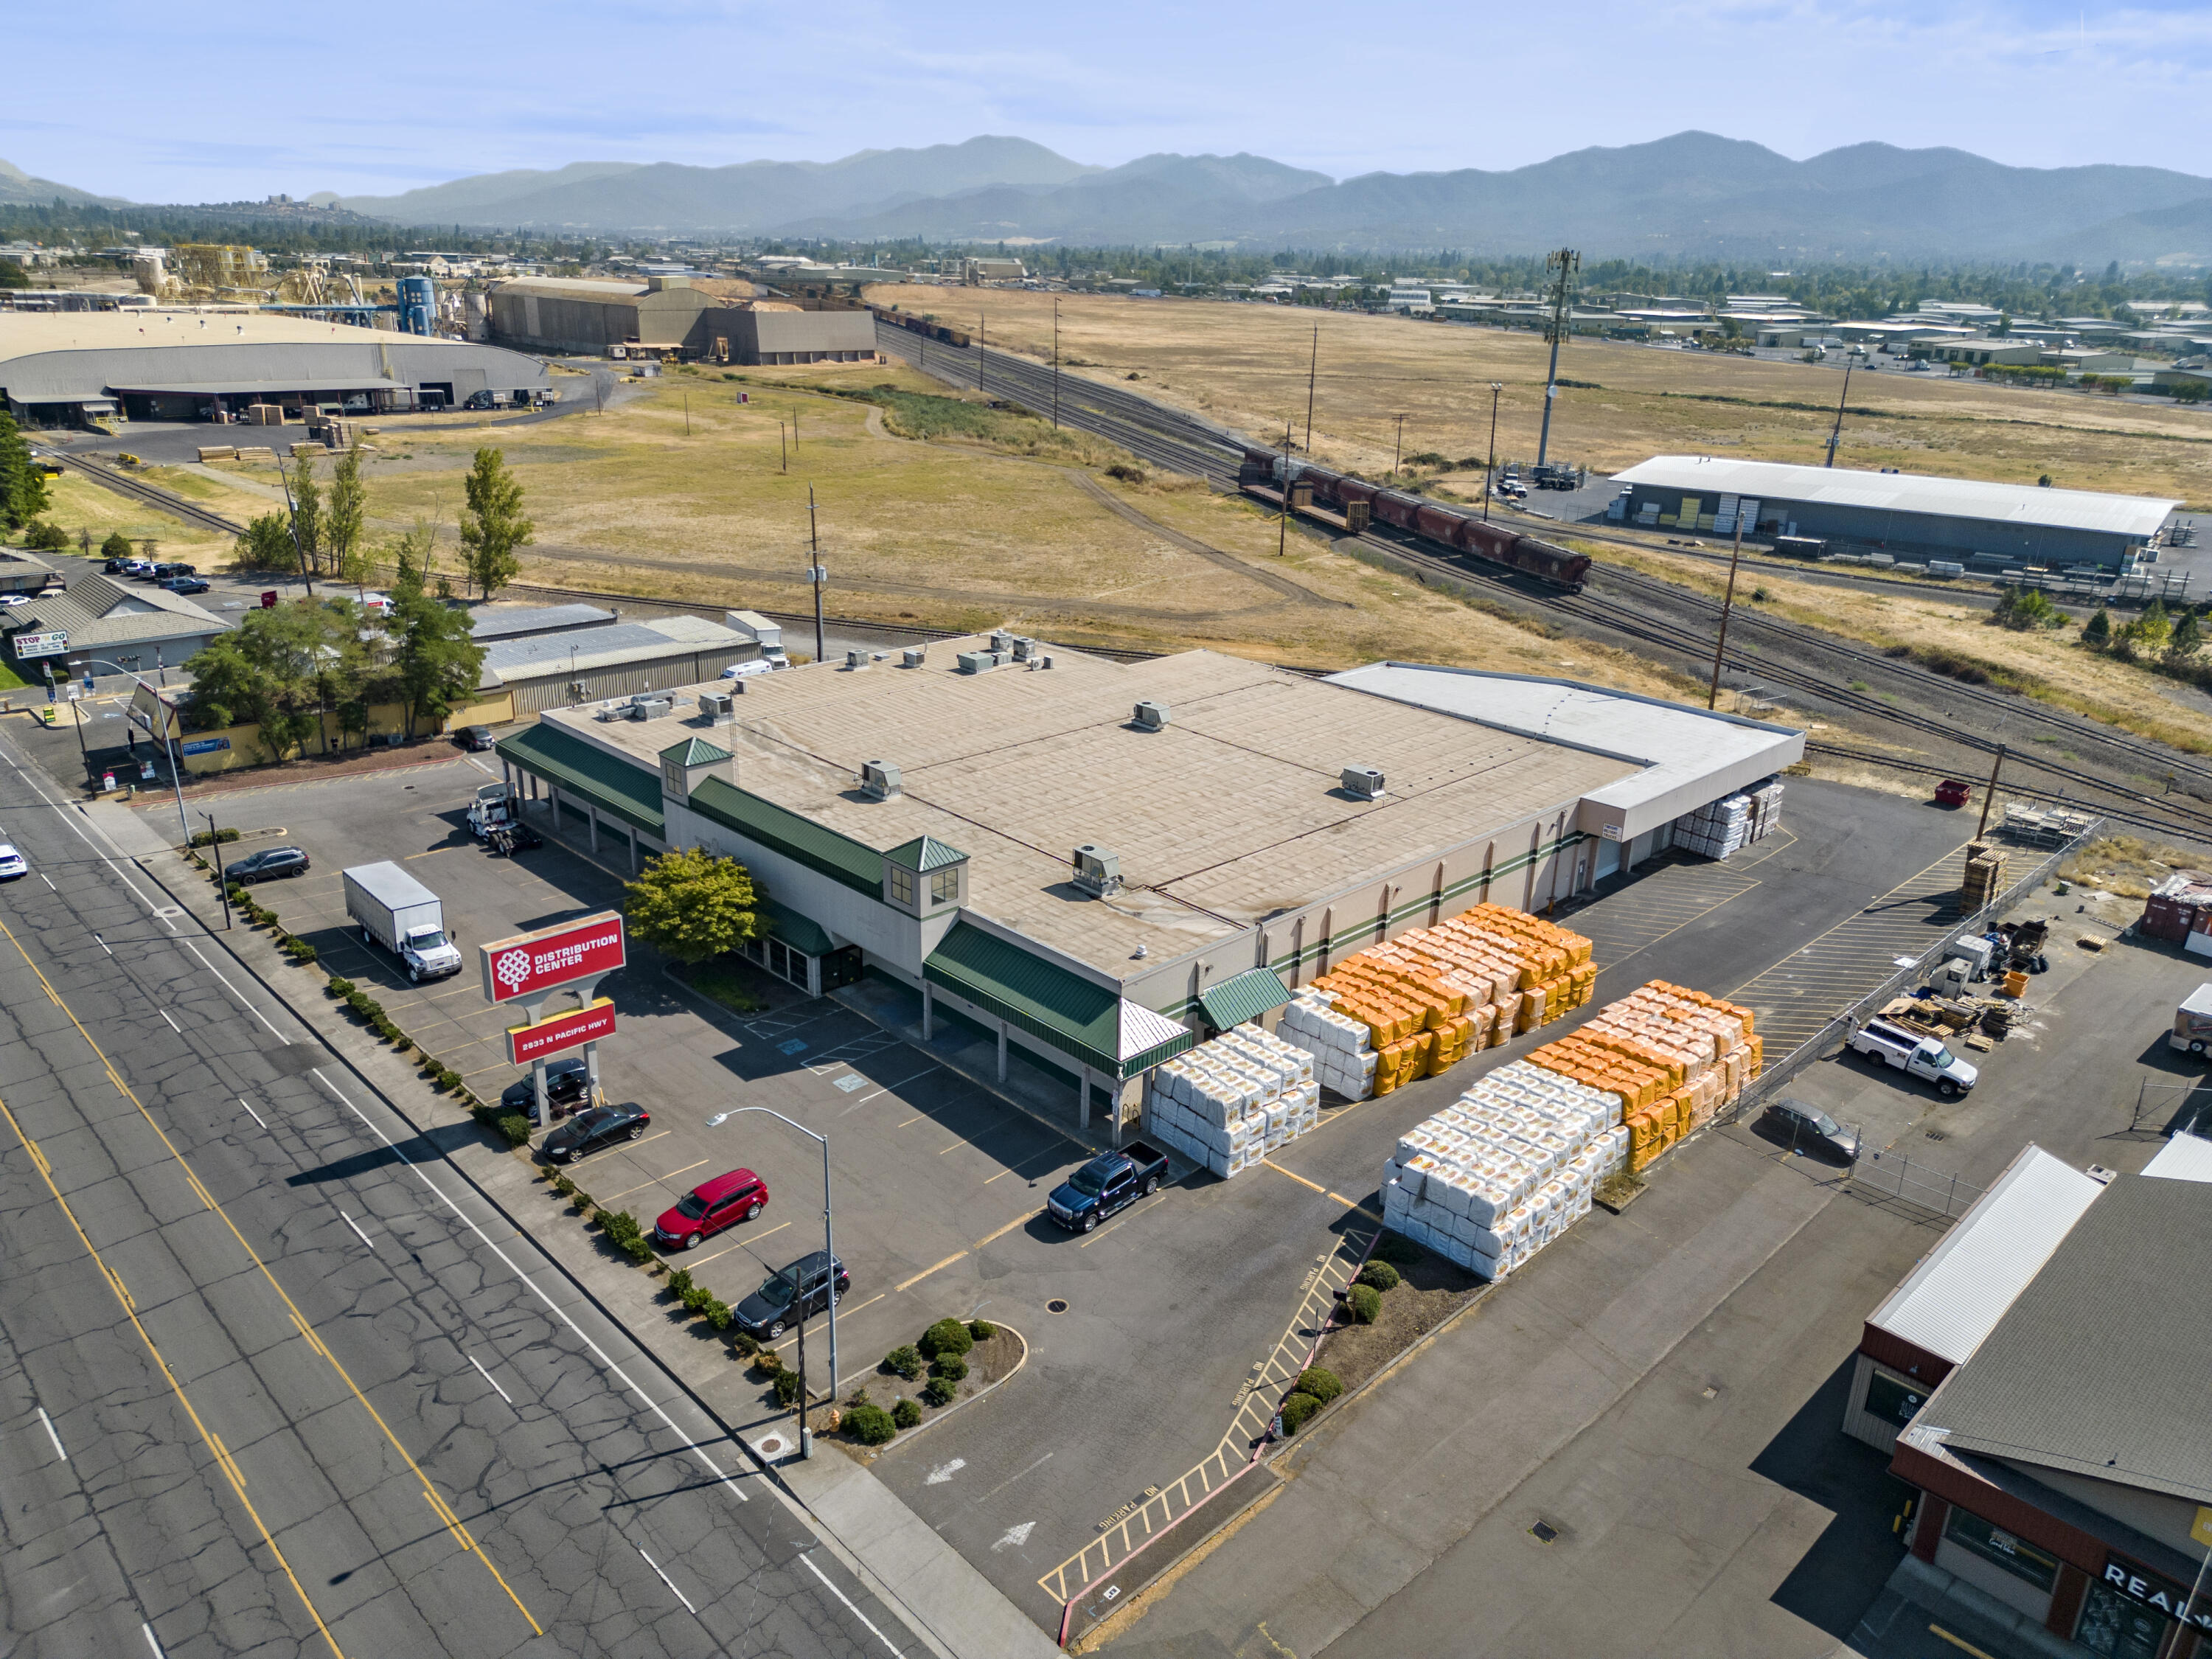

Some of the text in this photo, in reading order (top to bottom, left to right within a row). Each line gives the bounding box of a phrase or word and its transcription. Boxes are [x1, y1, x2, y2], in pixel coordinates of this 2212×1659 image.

[16, 636, 40, 644] STOP
[535, 934, 618, 965] DISTRIBUTION
[535, 953, 582, 975] CENTER
[522, 1040, 544, 1051] 2833
[555, 1025, 586, 1040] PACIFIC
[588, 1018, 607, 1030] HWY
[1300, 1254, 1326, 1290] NO PARKING
[1231, 1361, 1265, 1406] NO PARKING
[1099, 1485, 1159, 1530] NO PARKING
[2104, 1563, 2194, 1625] REAL
